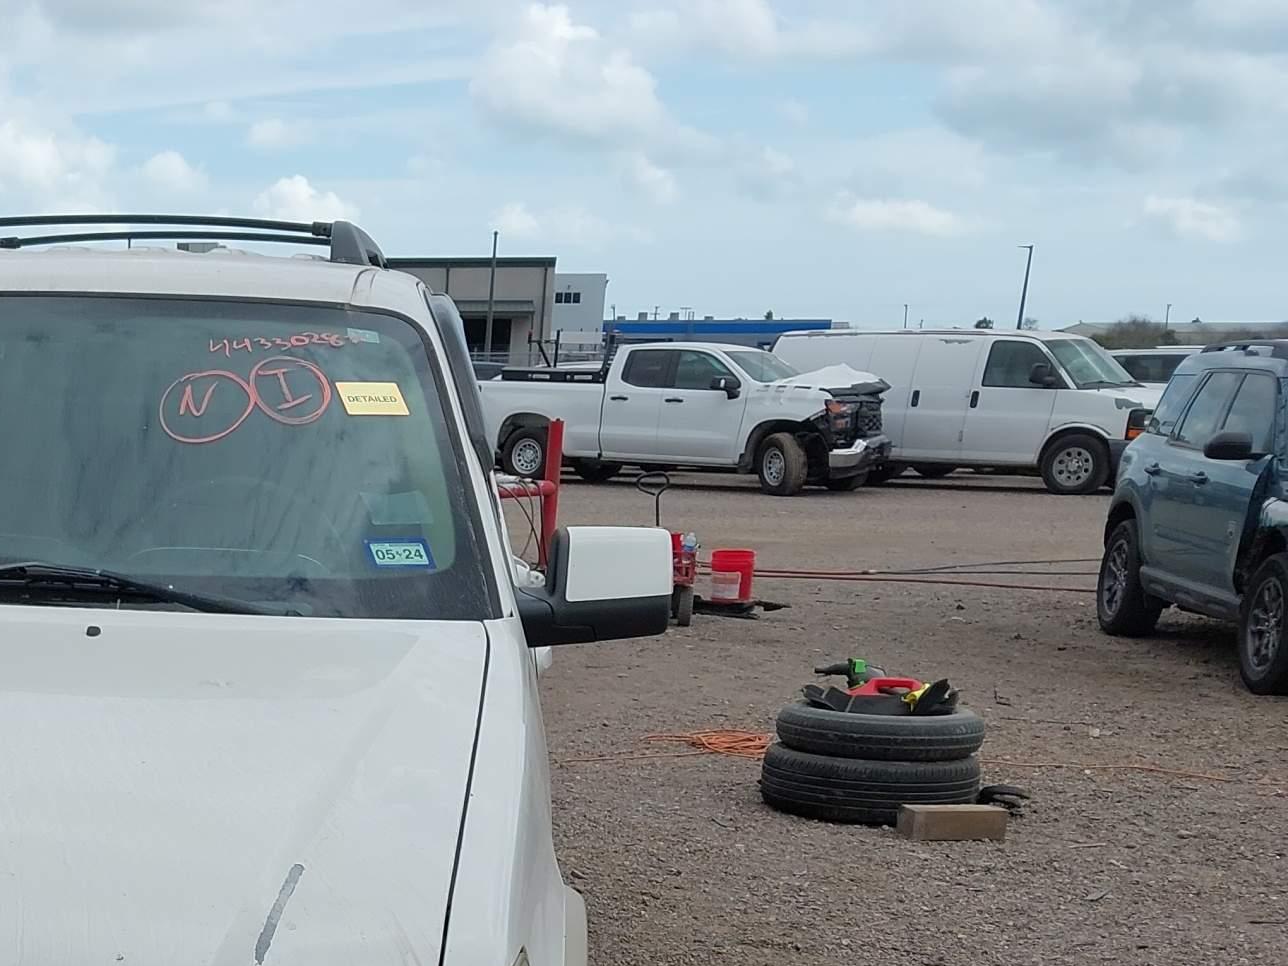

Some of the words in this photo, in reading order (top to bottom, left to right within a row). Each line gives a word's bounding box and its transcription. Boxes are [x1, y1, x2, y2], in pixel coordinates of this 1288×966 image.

[179, 381, 219, 416] N
[347, 395, 398, 404] DETAILED
[375, 549, 396, 560] 05
[402, 548, 424, 560] 24
